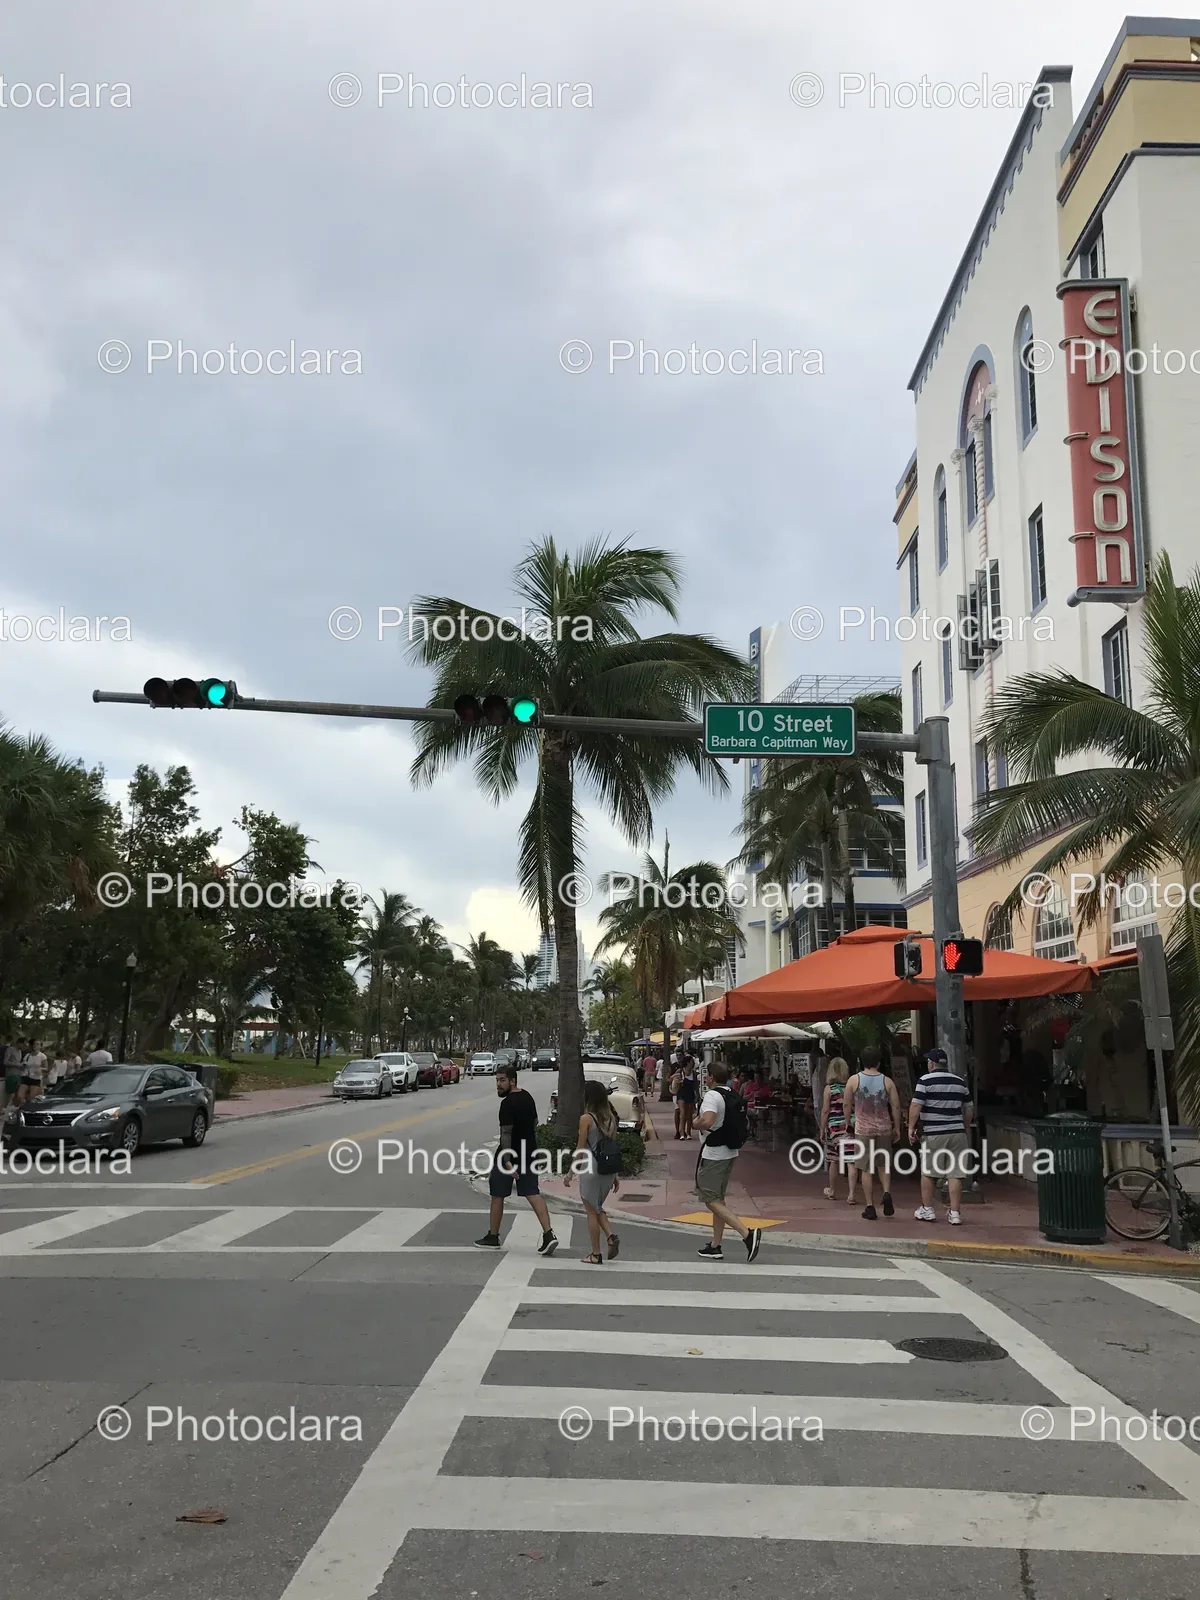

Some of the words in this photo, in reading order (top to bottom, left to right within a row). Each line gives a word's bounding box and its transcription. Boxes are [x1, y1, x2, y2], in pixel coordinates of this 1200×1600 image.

[737, 709, 764, 732] 10
[773, 714, 833, 733] Street
[711, 735, 757, 748] Barbara
[761, 736, 818, 751] Capitman
[822, 736, 848, 751] Way
